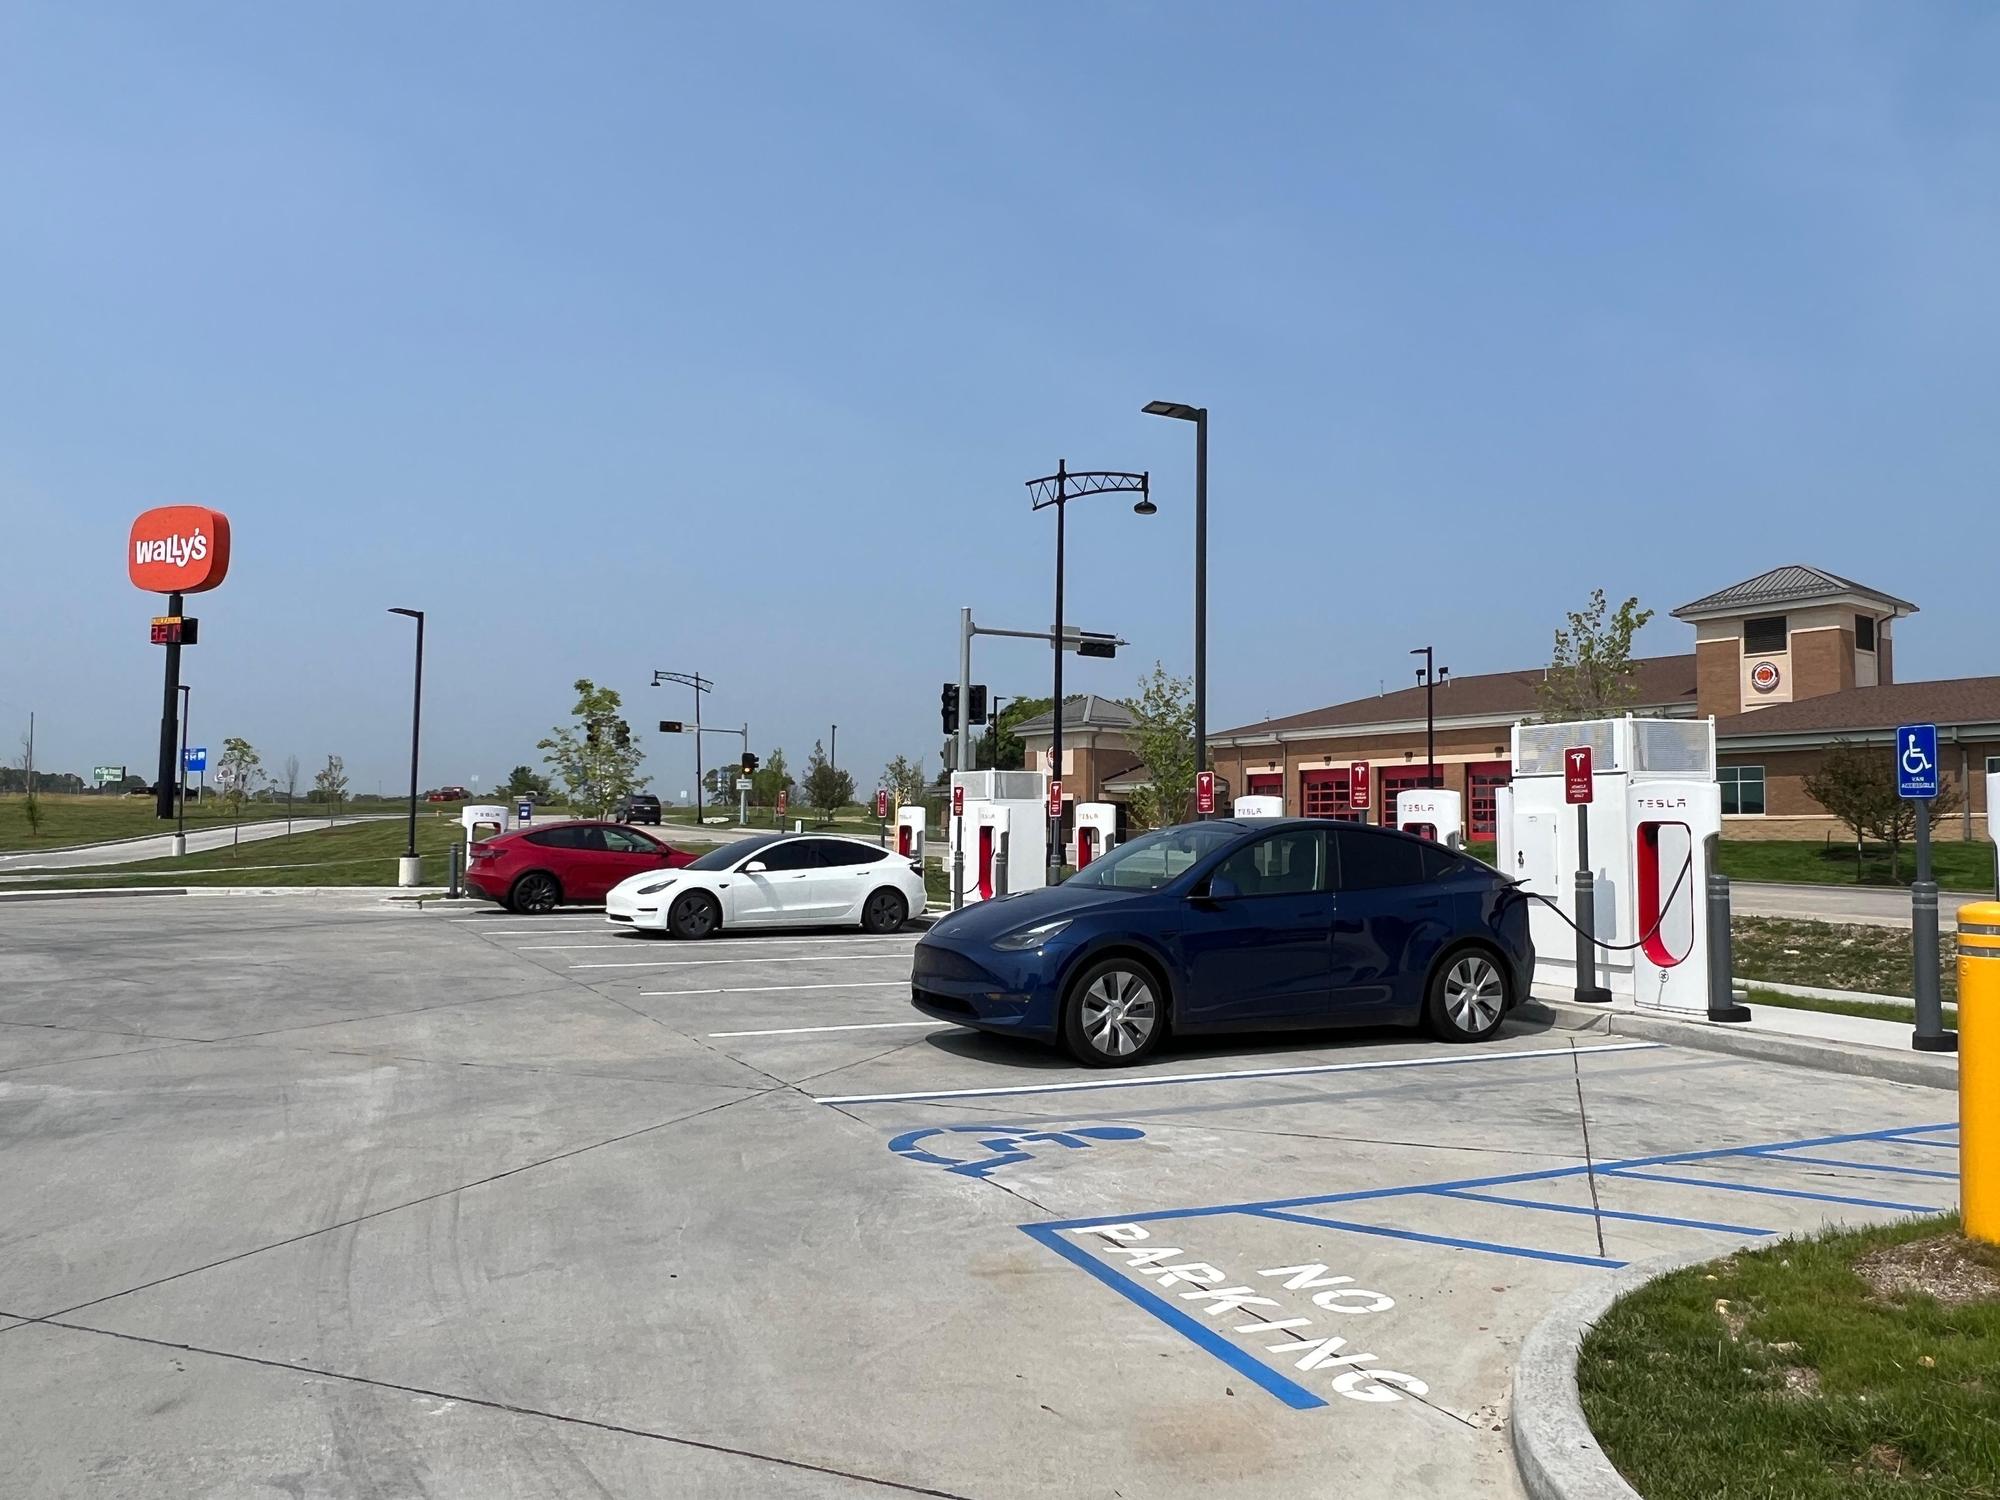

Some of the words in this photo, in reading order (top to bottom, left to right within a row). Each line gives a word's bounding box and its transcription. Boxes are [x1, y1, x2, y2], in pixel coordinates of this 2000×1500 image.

[1637, 798, 1687, 808] TESLA
[1237, 808, 1263, 816] TESLA
[1402, 804, 1435, 813] TESLA
[1256, 1263, 1395, 1314] NO
[1072, 1223, 1429, 1402] PARKING
